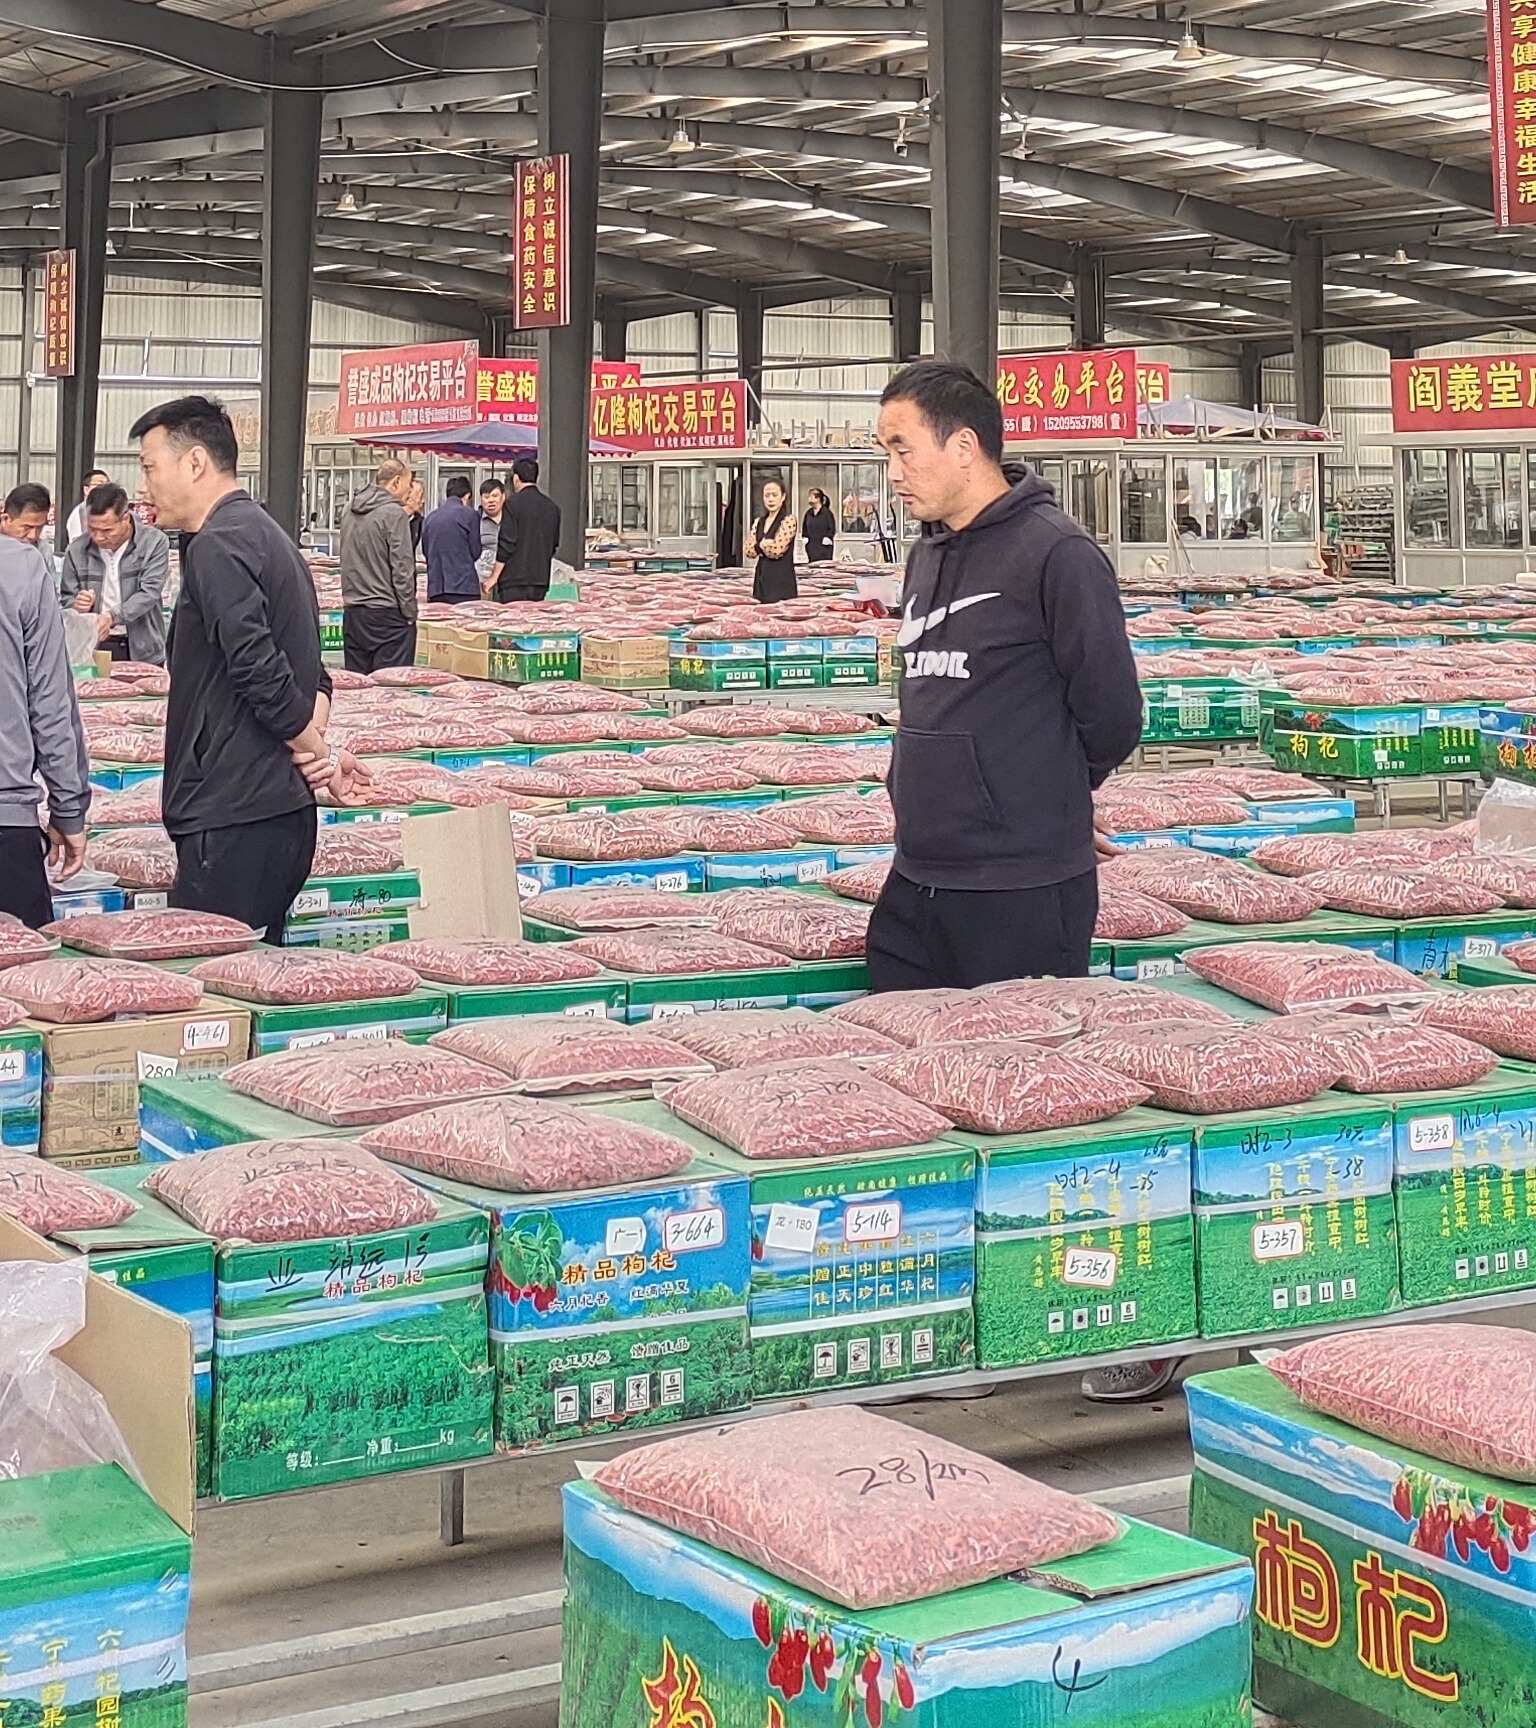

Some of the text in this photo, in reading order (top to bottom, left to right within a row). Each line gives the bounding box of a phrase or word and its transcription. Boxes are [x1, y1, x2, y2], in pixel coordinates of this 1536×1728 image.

[523, 175, 536, 314] 保障食药安全
[542, 171, 556, 313] 树立诚信意识
[1414, 1123, 1449, 1144] 5-358
[671, 1215, 715, 1244] 3-664
[1258, 1228, 1297, 1251] 5-357
[323, 1269, 425, 1299] 精品枸杞
[562, 1251, 677, 1285] 精品枸杞
[1067, 1254, 1111, 1280] 5-356
[668, 1374, 676, 1384] 6
[285, 1429, 455, 1470] 等级: 净重: kg
[1253, 1508, 1459, 1703] 枸杞
[39, 1638, 69, 1728] 宁药果
[95, 1628, 124, 1728] 六杞园
